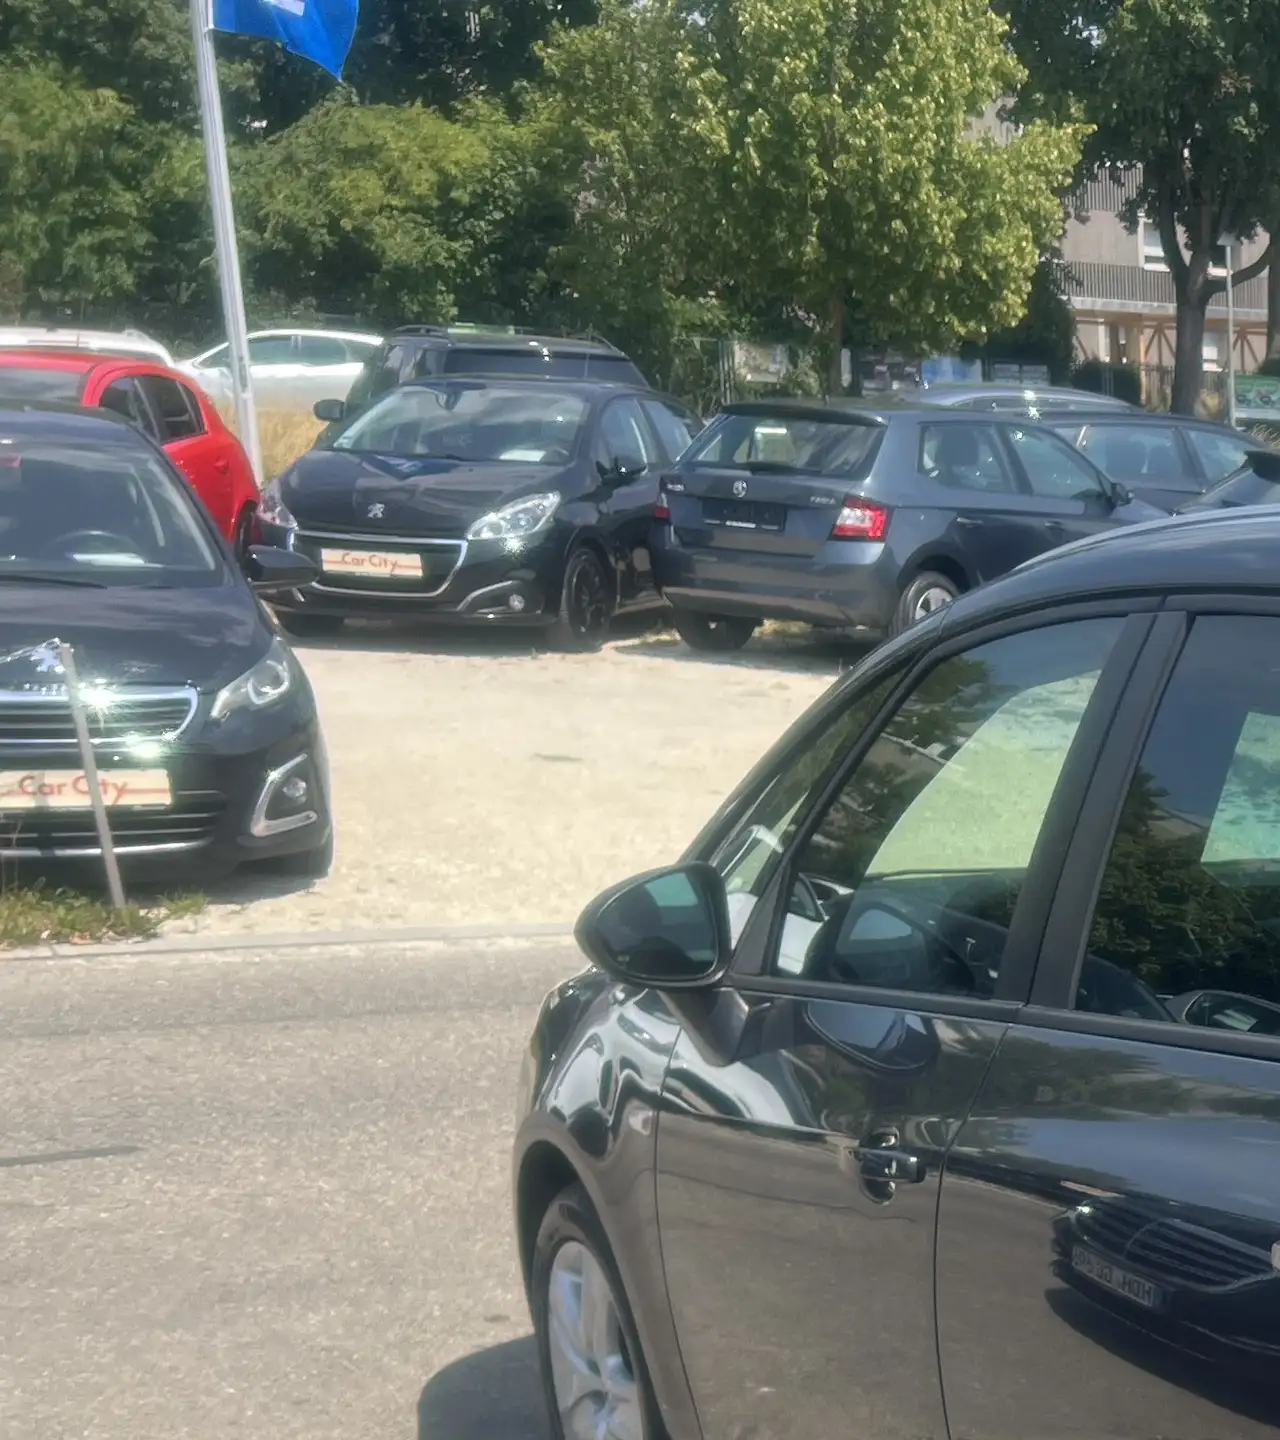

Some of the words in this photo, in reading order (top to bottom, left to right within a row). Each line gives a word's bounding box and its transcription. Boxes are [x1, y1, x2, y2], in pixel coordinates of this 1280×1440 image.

[342, 552, 365, 567] Car
[369, 554, 397, 575] City
[19, 774, 67, 796] Car
[73, 774, 128, 806] Cty
